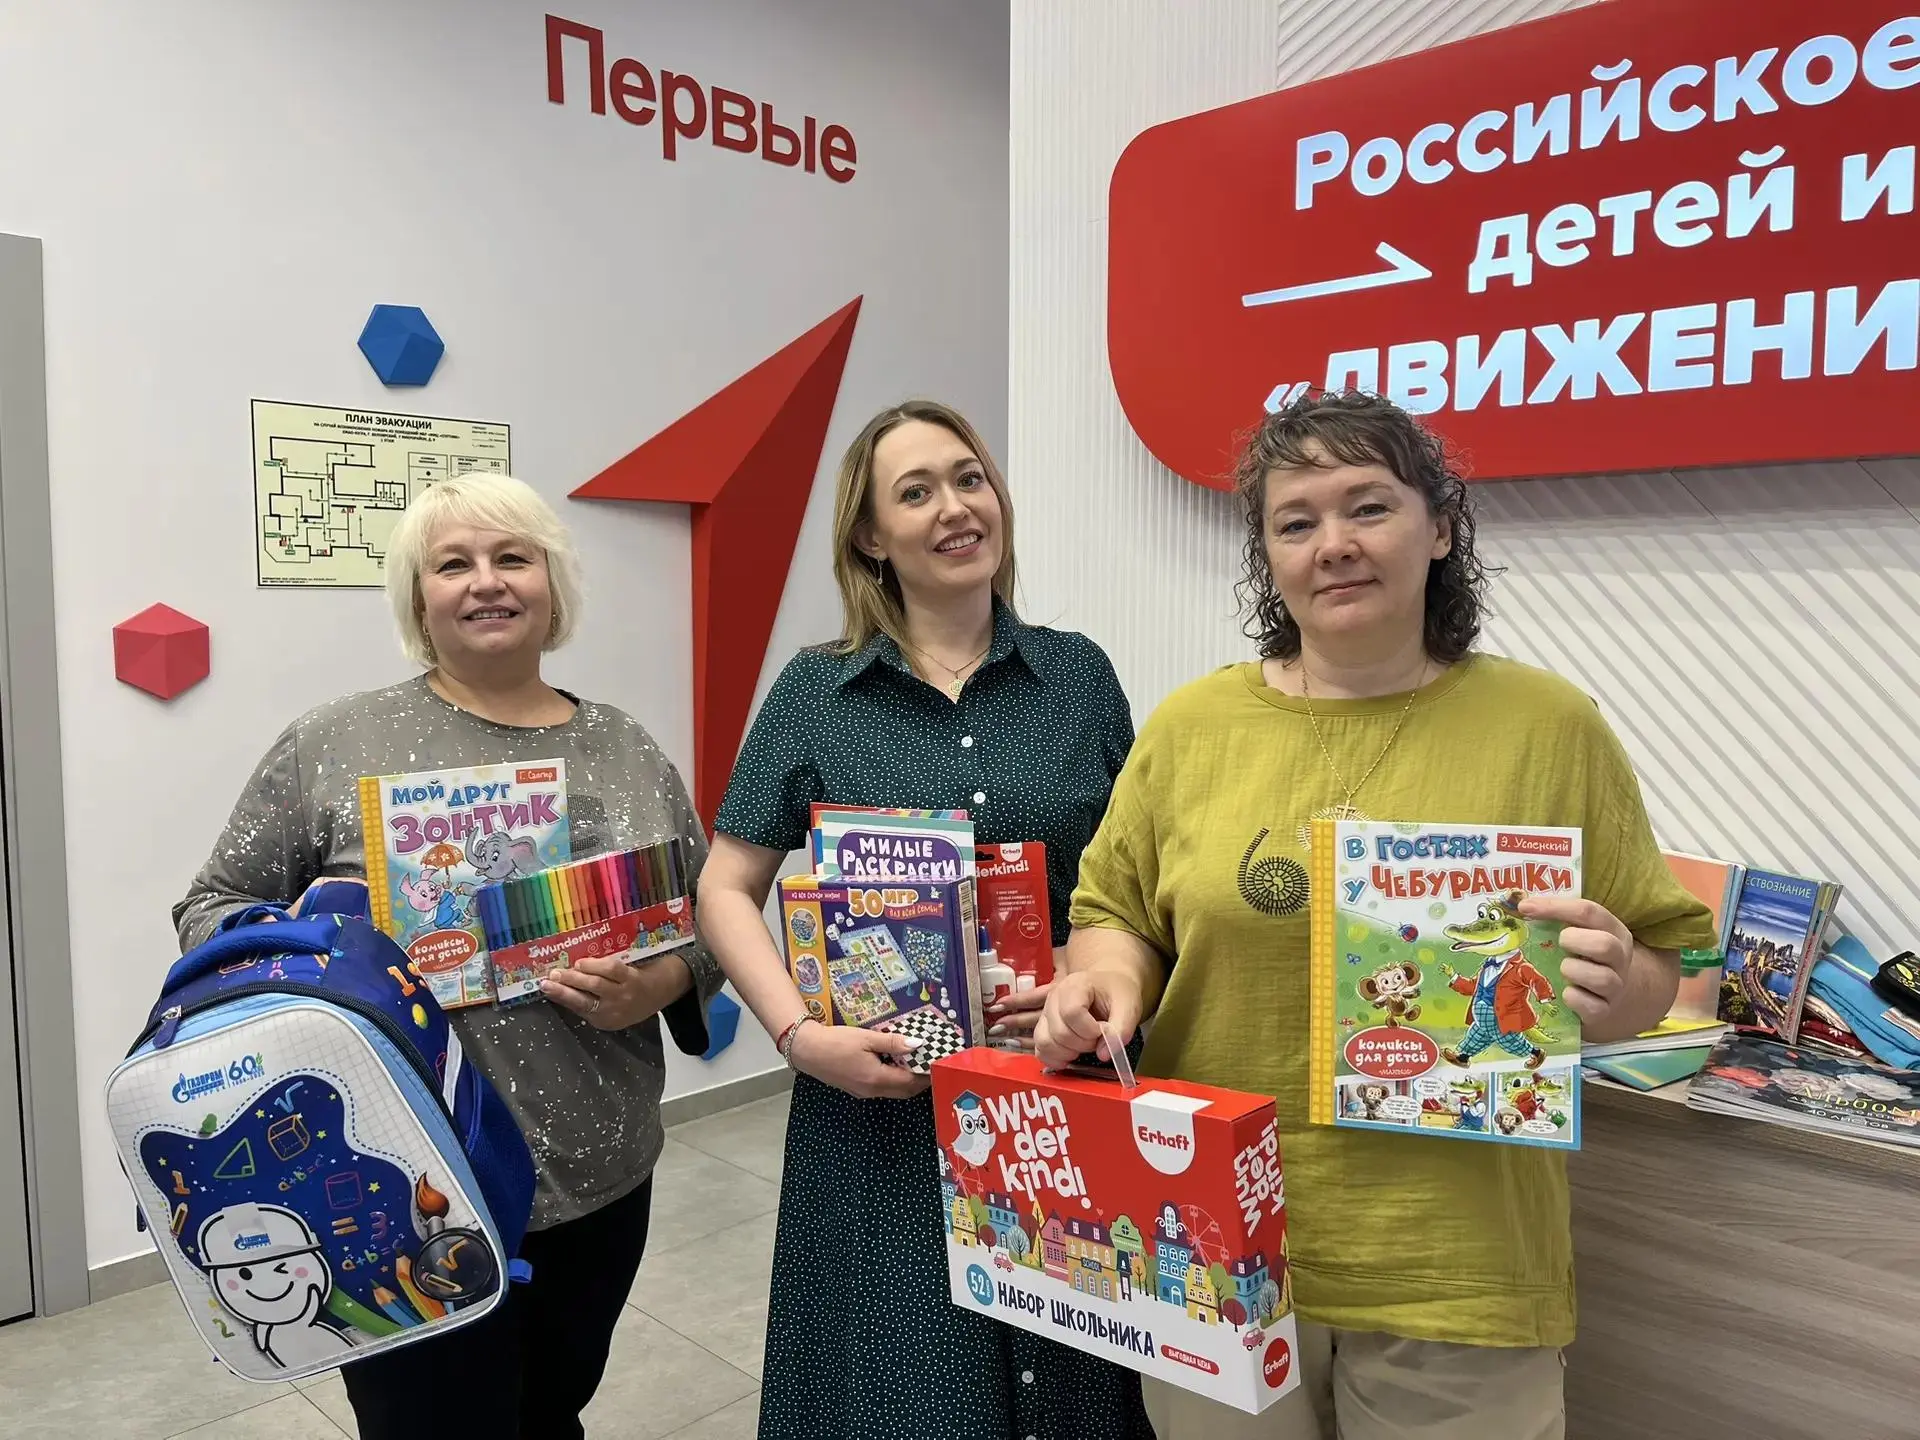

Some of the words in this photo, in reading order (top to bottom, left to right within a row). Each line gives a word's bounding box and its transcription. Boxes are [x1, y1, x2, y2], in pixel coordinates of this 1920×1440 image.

[545, 13, 857, 184] Первые
[1294, 16, 1920, 210] Российское
[1468, 145, 1796, 294] детей
[1841, 145, 1917, 222] и
[345, 413, 373, 424] ПЛАН
[375, 416, 432, 429] ЭВАКУАЦИИ
[391, 780, 445, 806] МОЙ
[448, 783, 511, 807] ДРУГ
[389, 794, 562, 854] ЗОНТИК
[859, 837, 933, 858] МИЛЫЕ
[1344, 836, 1367, 860] В
[1375, 833, 1489, 861] ГОСТЯХ
[1500, 836, 1511, 848] Э.
[1514, 836, 1569, 852] Успенский
[1344, 877, 1367, 904] У
[1370, 862, 1573, 900] ЧЕБУРАШКИ
[849, 888, 885, 918] 50
[883, 889, 918, 905] ИГР
[414, 938, 465, 955] комиксы
[438, 944, 471, 962] детей
[536, 923, 611, 957] Wunderkind!
[1355, 1052, 1382, 1067] для
[1386, 1050, 1428, 1067] детей
[1358, 1039, 1423, 1051] комиксы
[229, 1055, 257, 1081] 60
[985, 1089, 1067, 1133] Wun
[1014, 1120, 1070, 1161] der
[1138, 1125, 1190, 1151] Erhaft
[998, 1154, 1091, 1209] kind!
[1082, 1257, 1101, 1272] SCHOOL
[970, 1270, 986, 1297] 52
[997, 1281, 1045, 1318] НАБОР
[1050, 1298, 1156, 1359] ШКОЛЬНИКА
[1264, 1352, 1289, 1375] Erhaft
